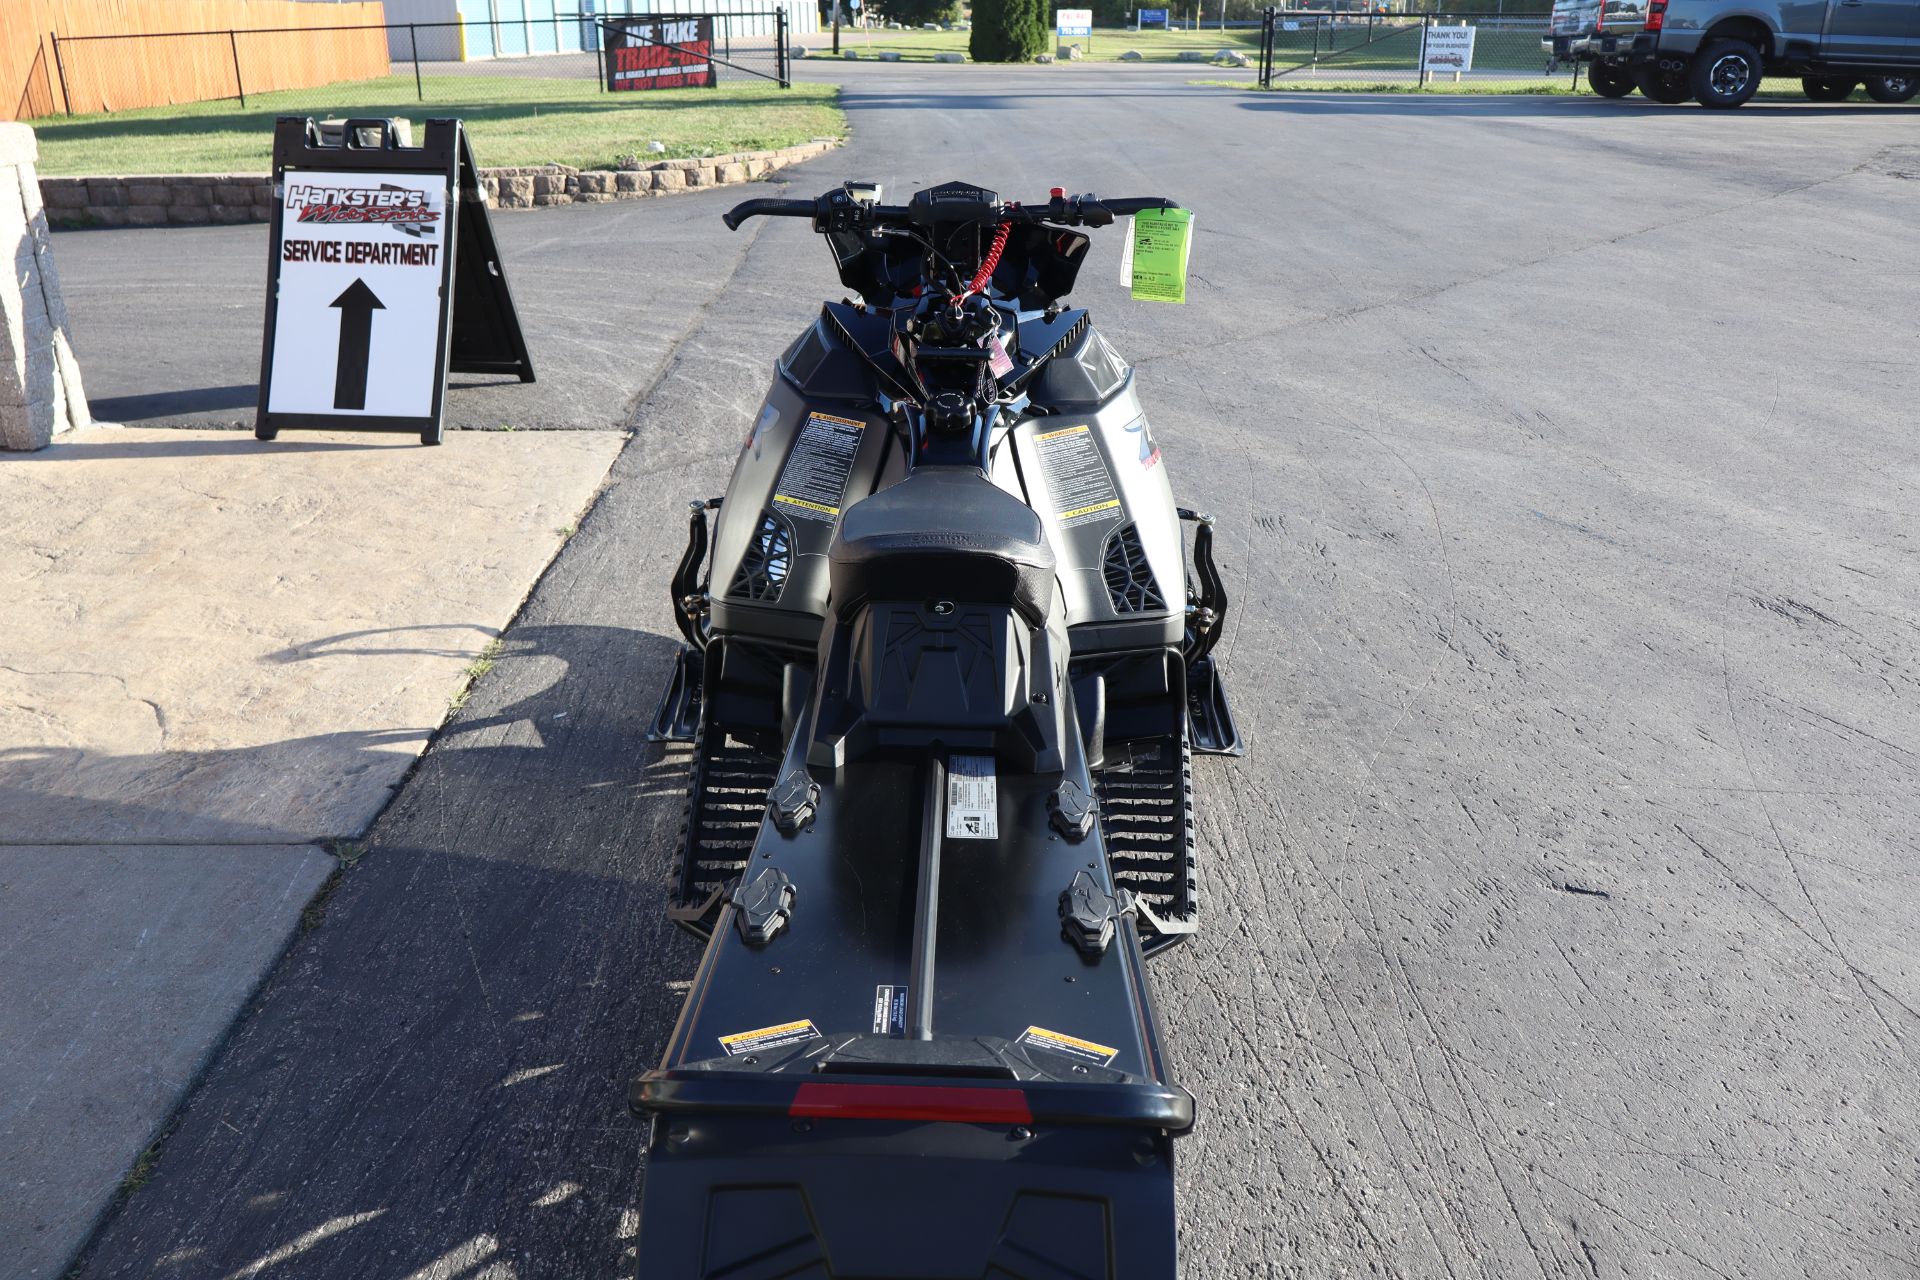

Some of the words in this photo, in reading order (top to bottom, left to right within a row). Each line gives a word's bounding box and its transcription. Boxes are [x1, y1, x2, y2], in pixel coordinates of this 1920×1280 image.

[625, 25, 653, 47] WE
[658, 21, 698, 43] TAKE
[283, 239, 342, 263] SERVICE
[345, 241, 439, 266] DEPARTMENT
[792, 499, 832, 514] ATTENTION
[1072, 502, 1109, 517] CAUTION
